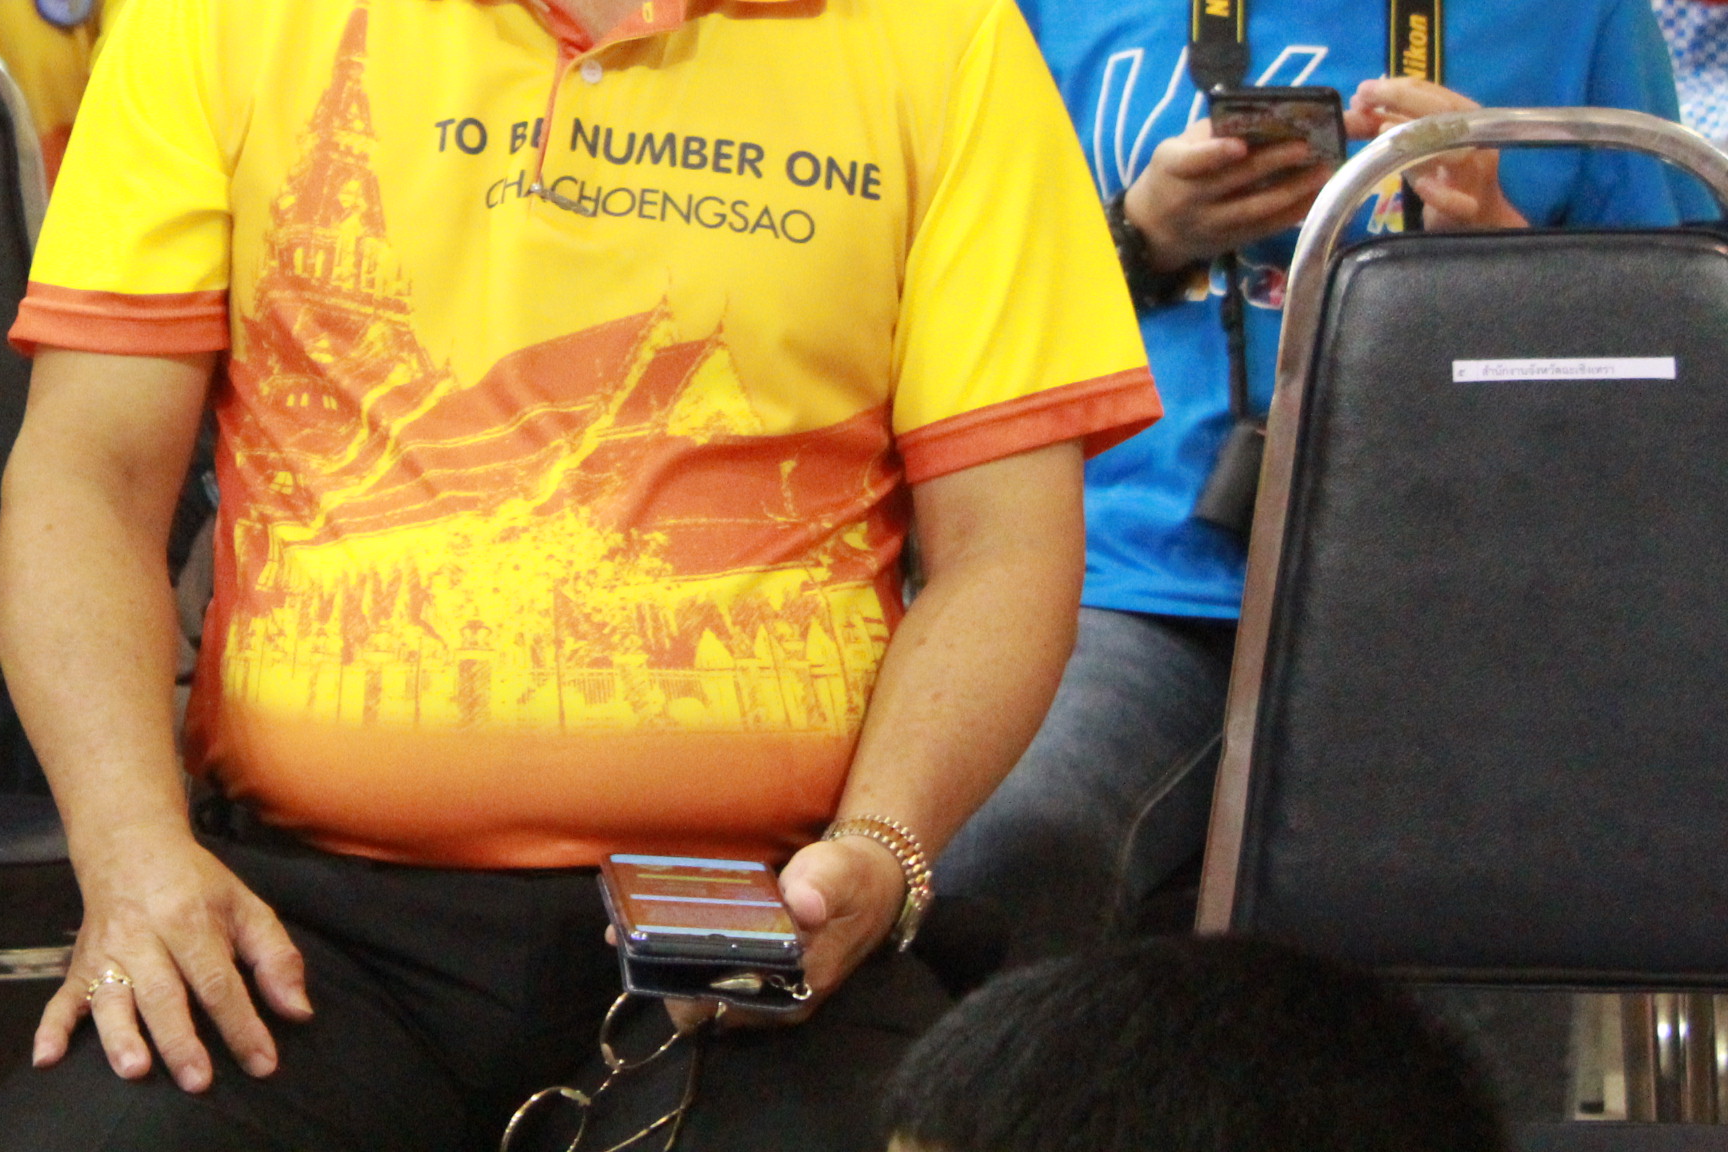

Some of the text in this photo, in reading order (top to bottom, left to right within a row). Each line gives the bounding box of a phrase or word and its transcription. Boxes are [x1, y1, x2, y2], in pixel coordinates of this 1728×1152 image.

[434, 117, 487, 155] TO
[569, 117, 765, 180] NUMBER
[784, 150, 882, 201] ONE
[485, 169, 816, 244] CHACHOENGSAO
